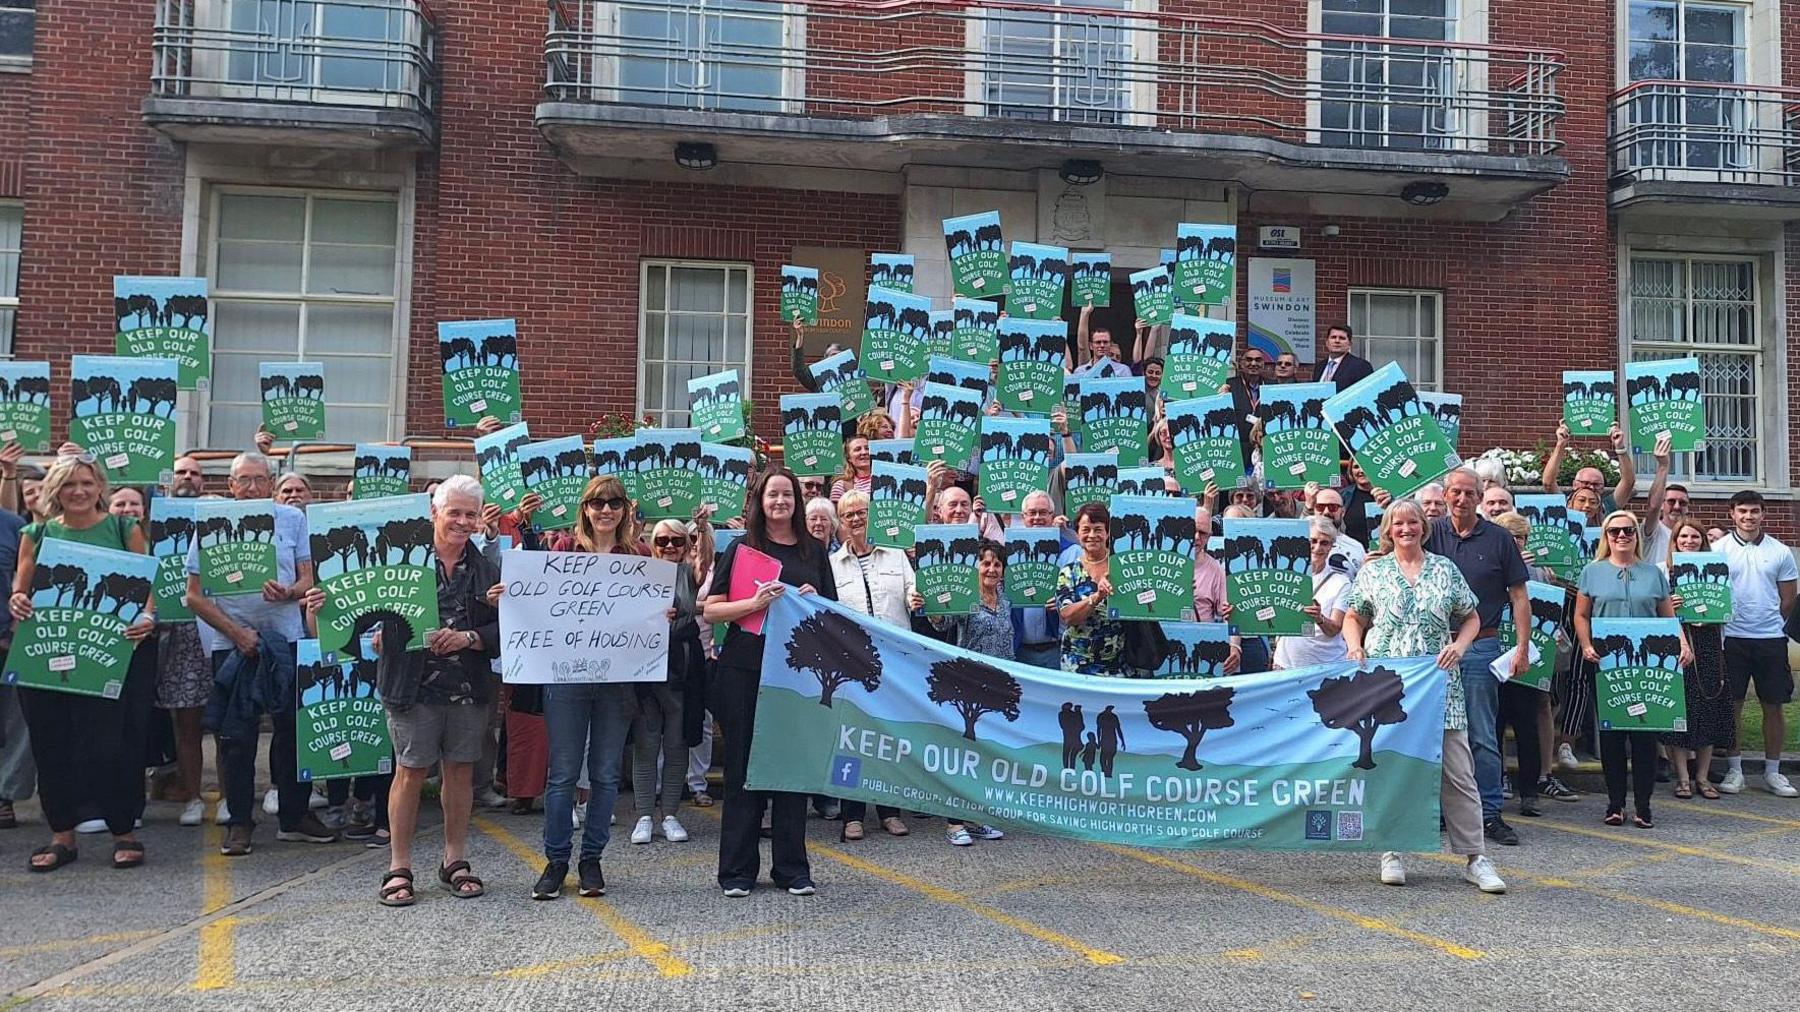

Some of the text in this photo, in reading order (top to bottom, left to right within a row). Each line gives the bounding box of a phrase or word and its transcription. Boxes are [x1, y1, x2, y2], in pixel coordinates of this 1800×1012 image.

[955, 252, 999, 266] KEEP OUR
[960, 261, 998, 273] OLD GOLF
[959, 269, 1002, 285] COURSE GREEN
[1254, 303, 1310, 312] SWINDON
[870, 330, 919, 348] KEEP OUR
[872, 341, 914, 356] OLD GOLF
[868, 351, 916, 369] COURSE GREEN
[450, 368, 511, 383] KEEP OUR
[1006, 362, 1057, 375] KEEP OUR
[1008, 372, 1054, 383] OLD GOLF
[454, 379, 508, 392] OLD GOLF
[1004, 384, 1056, 396] COURSE GREEN
[269, 398, 318, 408] KEEP OUR
[452, 390, 483, 407] COURSE
[485, 390, 513, 405] GREEN
[271, 406, 316, 416] OLD GOLF
[1637, 402, 1694, 415] KEEP OUR
[82, 414, 165, 431] KEEP OUR
[270, 415, 318, 426] COURSE GREEN
[1089, 419, 1140, 431] KEEP OUR
[1640, 413, 1692, 424] OLD GOLF
[87, 428, 161, 443] OLD GOLF
[790, 431, 835, 441] KEEP OUR
[1092, 429, 1137, 439] OLD GOLF
[1639, 421, 1696, 436] COURSE GREEN
[1270, 431, 1330, 444] KEEP OUR
[1361, 417, 1422, 457] KEEP OUR
[89, 442, 165, 460] OURSE GREEN
[792, 440, 833, 450] OLD GOLF
[1090, 440, 1141, 452] COURSE GREEN
[1275, 442, 1328, 454] OLD GOLF
[1373, 430, 1425, 465] OLD GOLF
[791, 448, 836, 461] COURSE GREEN
[1272, 453, 1301, 469] COURSE
[1305, 453, 1331, 466] GREEN
[1378, 453, 1405, 479] COURSE
[1407, 442, 1437, 455] GREEN
[641, 469, 695, 481] KEEP OUR
[645, 479, 691, 490] OLD GOLF
[641, 489, 670, 502] COURSE
[671, 488, 695, 501] GREEN
[206, 543, 268, 557] KEEP OUR
[211, 553, 265, 566] OLD GOLF
[543, 553, 648, 577] KEEP OUR
[1119, 553, 1186, 568] KEEP OUR
[209, 562, 238, 578] COURSE
[242, 561, 269, 574] GREEN
[1122, 566, 1182, 580] OLD GOLF
[327, 568, 423, 595] KEEP OUR
[1235, 571, 1303, 585] KEEP OUR
[508, 580, 673, 599] OLD GOLF COURSE
[1118, 579, 1185, 597] COURSE GREEN
[1240, 584, 1300, 597] OLD GOLF
[335, 585, 419, 610] OLD GOLF
[1237, 597, 1304, 613] COURSE GREEN
[549, 600, 616, 617] GREEN
[35, 610, 127, 635] KEEP OUR
[36, 626, 118, 648] OLD GOLF
[506, 629, 661, 650] FREE OF HOUSING
[25, 641, 76, 657] COURSE
[79, 644, 118, 667] GREEN
[1605, 669, 1674, 682] KEEP OUR
[1610, 681, 1672, 693] OLD GOLF
[1608, 693, 1676, 709] COURSE GREEN
[308, 701, 383, 719] KEEP OUR
[312, 715, 380, 733] OLD GOLF
[308, 730, 347, 752] COURSE
[350, 730, 383, 747] GREEN
[839, 724, 1366, 806] KEEP OUR OLD GOLF COURSE GREEN
[863, 779, 899, 795] PUBLIC
[946, 796, 984, 812] ACTION
[989, 806, 1023, 820] GROUP
[1026, 811, 1046, 823] FOR
[1050, 815, 1087, 829] SAVING
[1091, 820, 1163, 835] HIGHWORTH'S
[1167, 827, 1187, 836] OLD
[1192, 828, 1220, 838] GOLF
[1224, 828, 1264, 839] COURSE
[985, 786, 1217, 823] WWW.KEEPHIGHWORTHGREEN.COM
